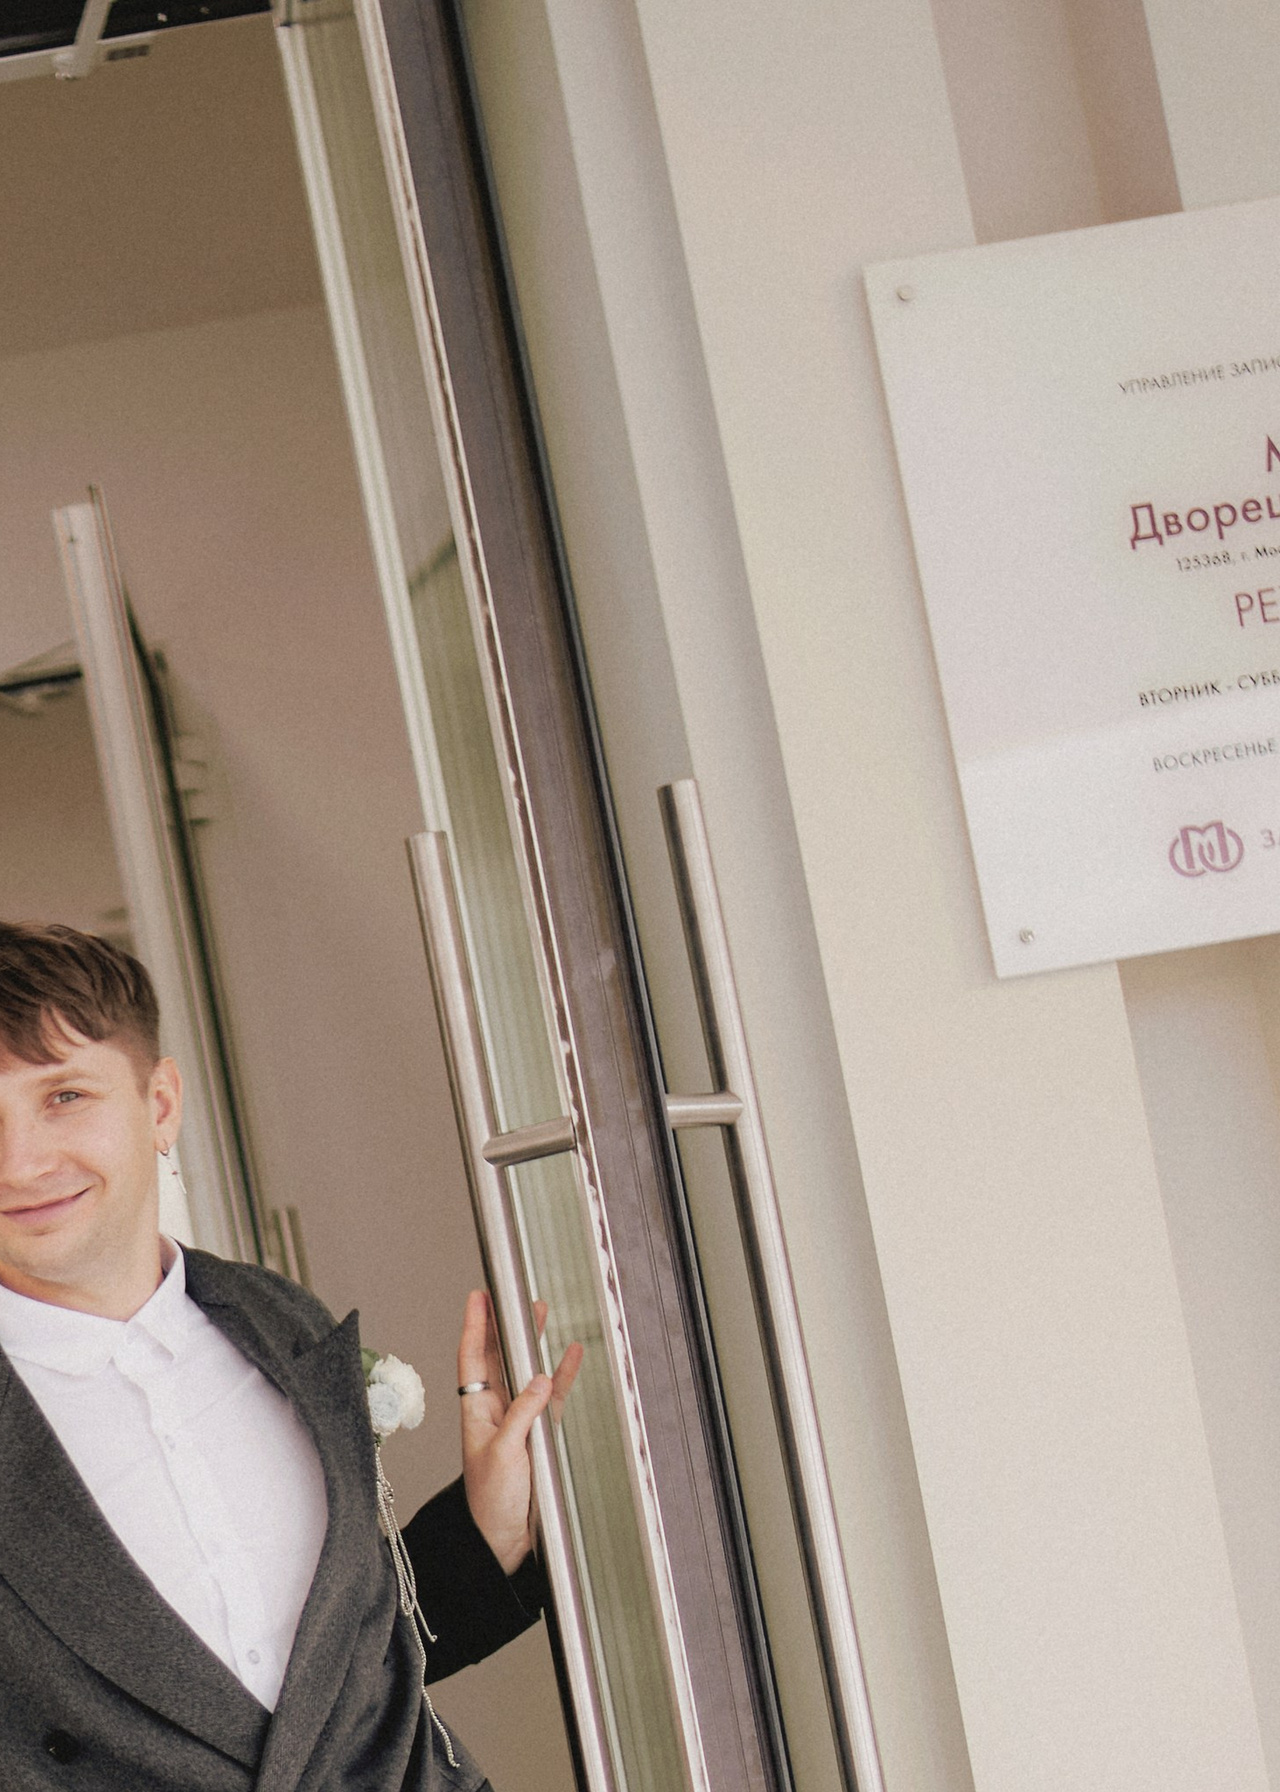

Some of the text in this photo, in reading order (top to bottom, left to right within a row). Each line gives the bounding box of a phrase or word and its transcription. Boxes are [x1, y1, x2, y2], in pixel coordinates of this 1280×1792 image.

[1117, 364, 1225, 394] УПРАВЛЕНИЕ
[1254, 545, 1280, 560] Мо
[1139, 680, 1221, 707] ВТОРНИК
[1152, 738, 1277, 772] ВОСКРЕСЕНЬЕ
